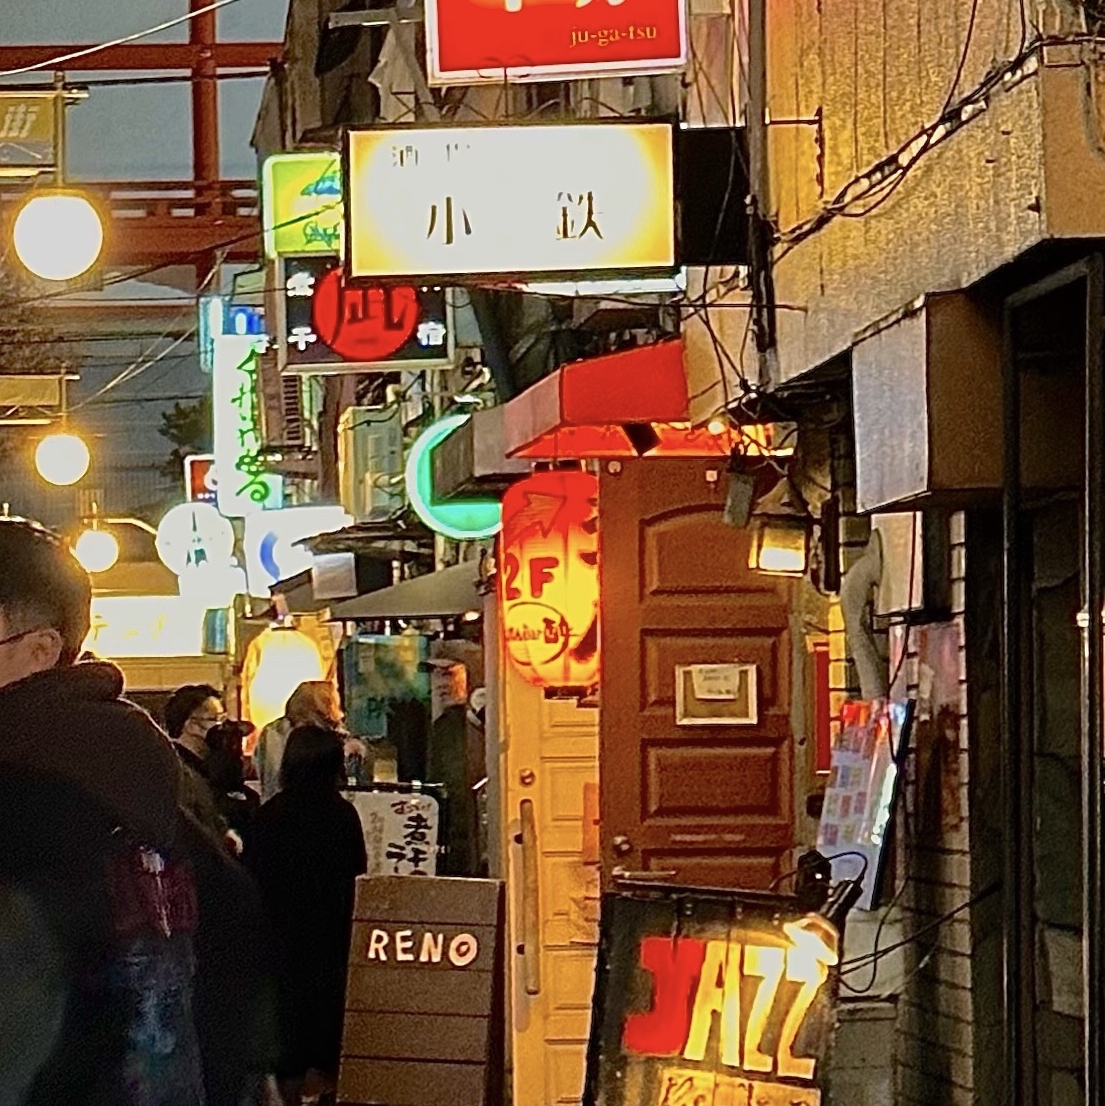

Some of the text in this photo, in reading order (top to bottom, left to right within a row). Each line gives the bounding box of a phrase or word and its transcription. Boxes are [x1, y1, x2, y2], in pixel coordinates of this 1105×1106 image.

[569, 25, 657, 48] ju-ga-tsu
[505, 552, 559, 600] 2F
[368, 928, 478, 966] RENO
[623, 936, 829, 1080] JAZZ
